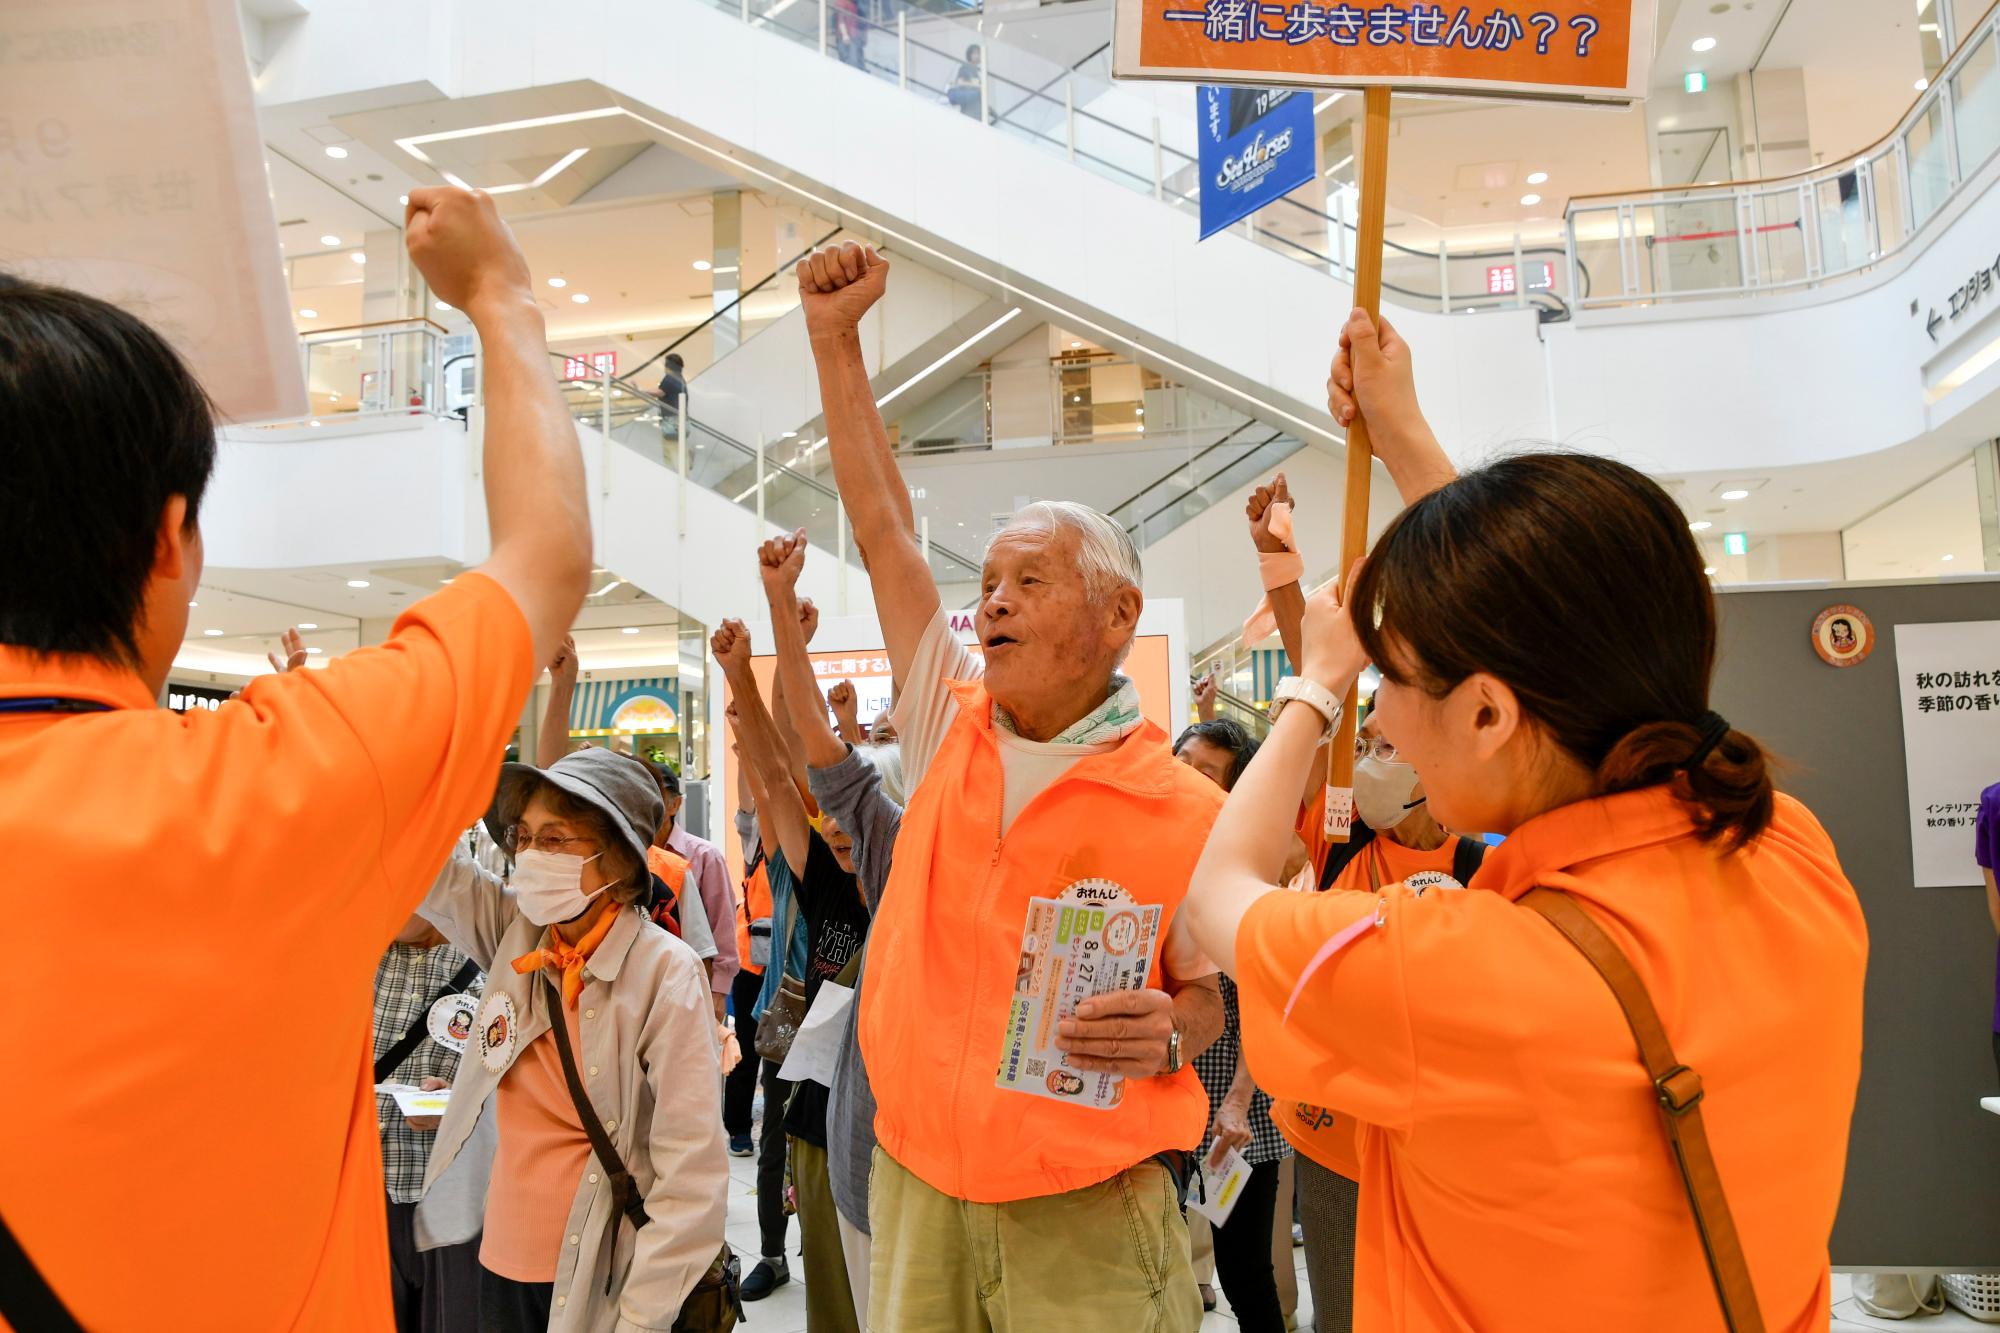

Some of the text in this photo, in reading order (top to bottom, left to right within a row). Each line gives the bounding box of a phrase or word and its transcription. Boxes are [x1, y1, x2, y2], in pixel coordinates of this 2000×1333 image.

[1164, 0, 1599, 56] 一緒に歩きませんか？？
[950, 615, 976, 632] MA
[811, 657, 892, 675] 症に関する
[1076, 887, 1119, 900] おれんじ
